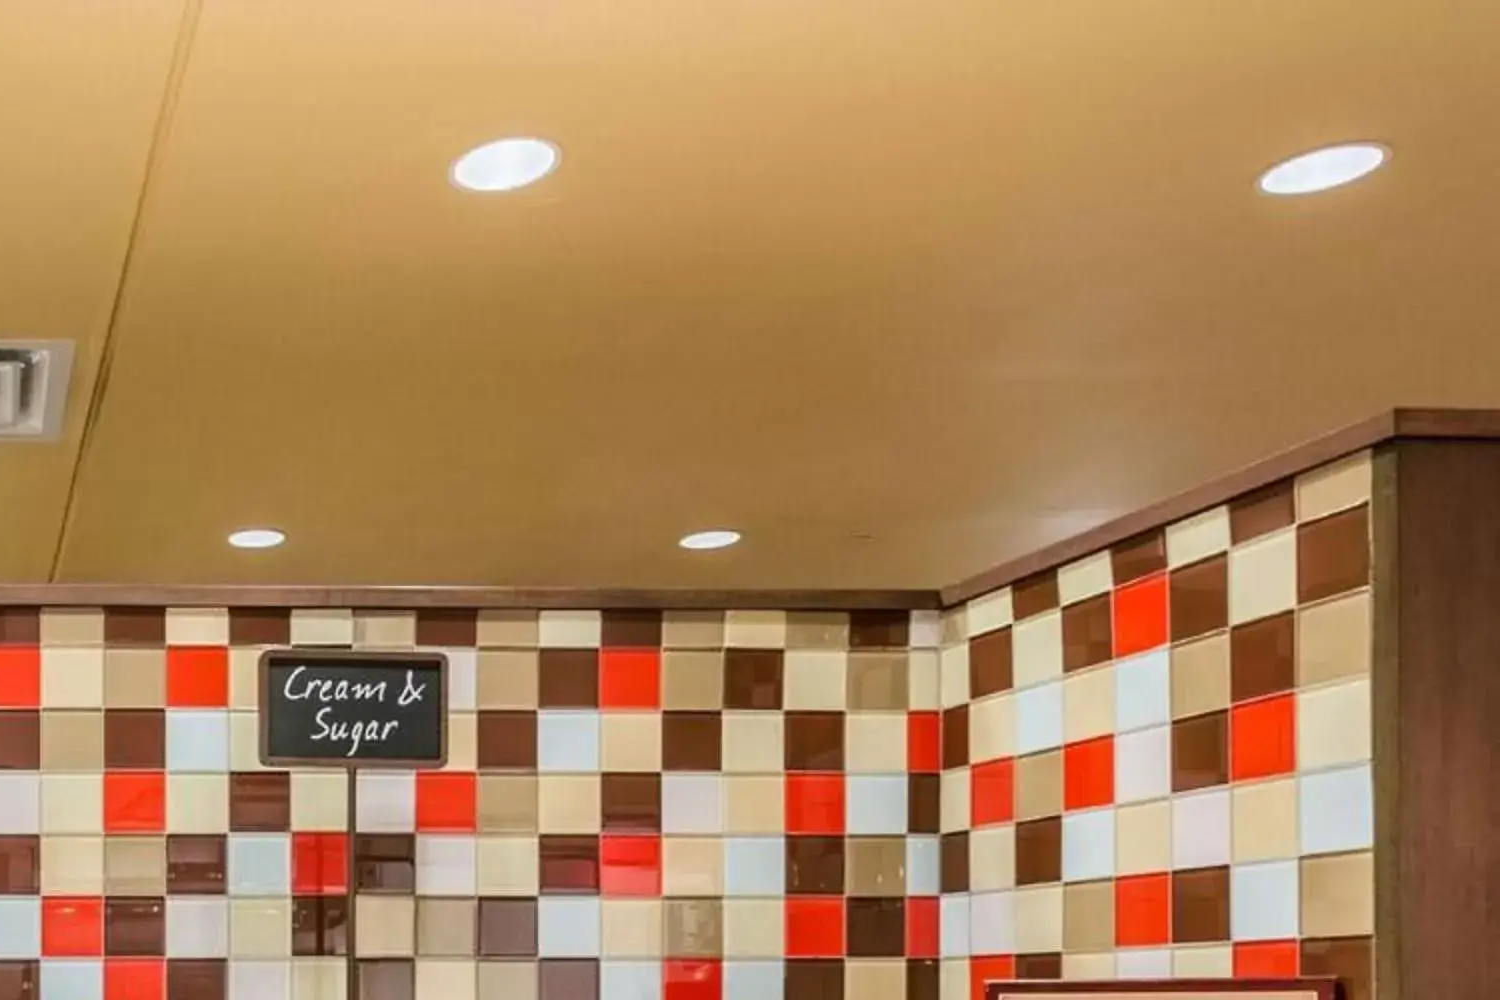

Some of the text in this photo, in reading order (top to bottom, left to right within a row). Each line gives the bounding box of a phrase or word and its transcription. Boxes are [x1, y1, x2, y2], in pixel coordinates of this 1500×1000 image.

[283, 666, 426, 705] Cream &
[310, 706, 399, 757] Sugar
